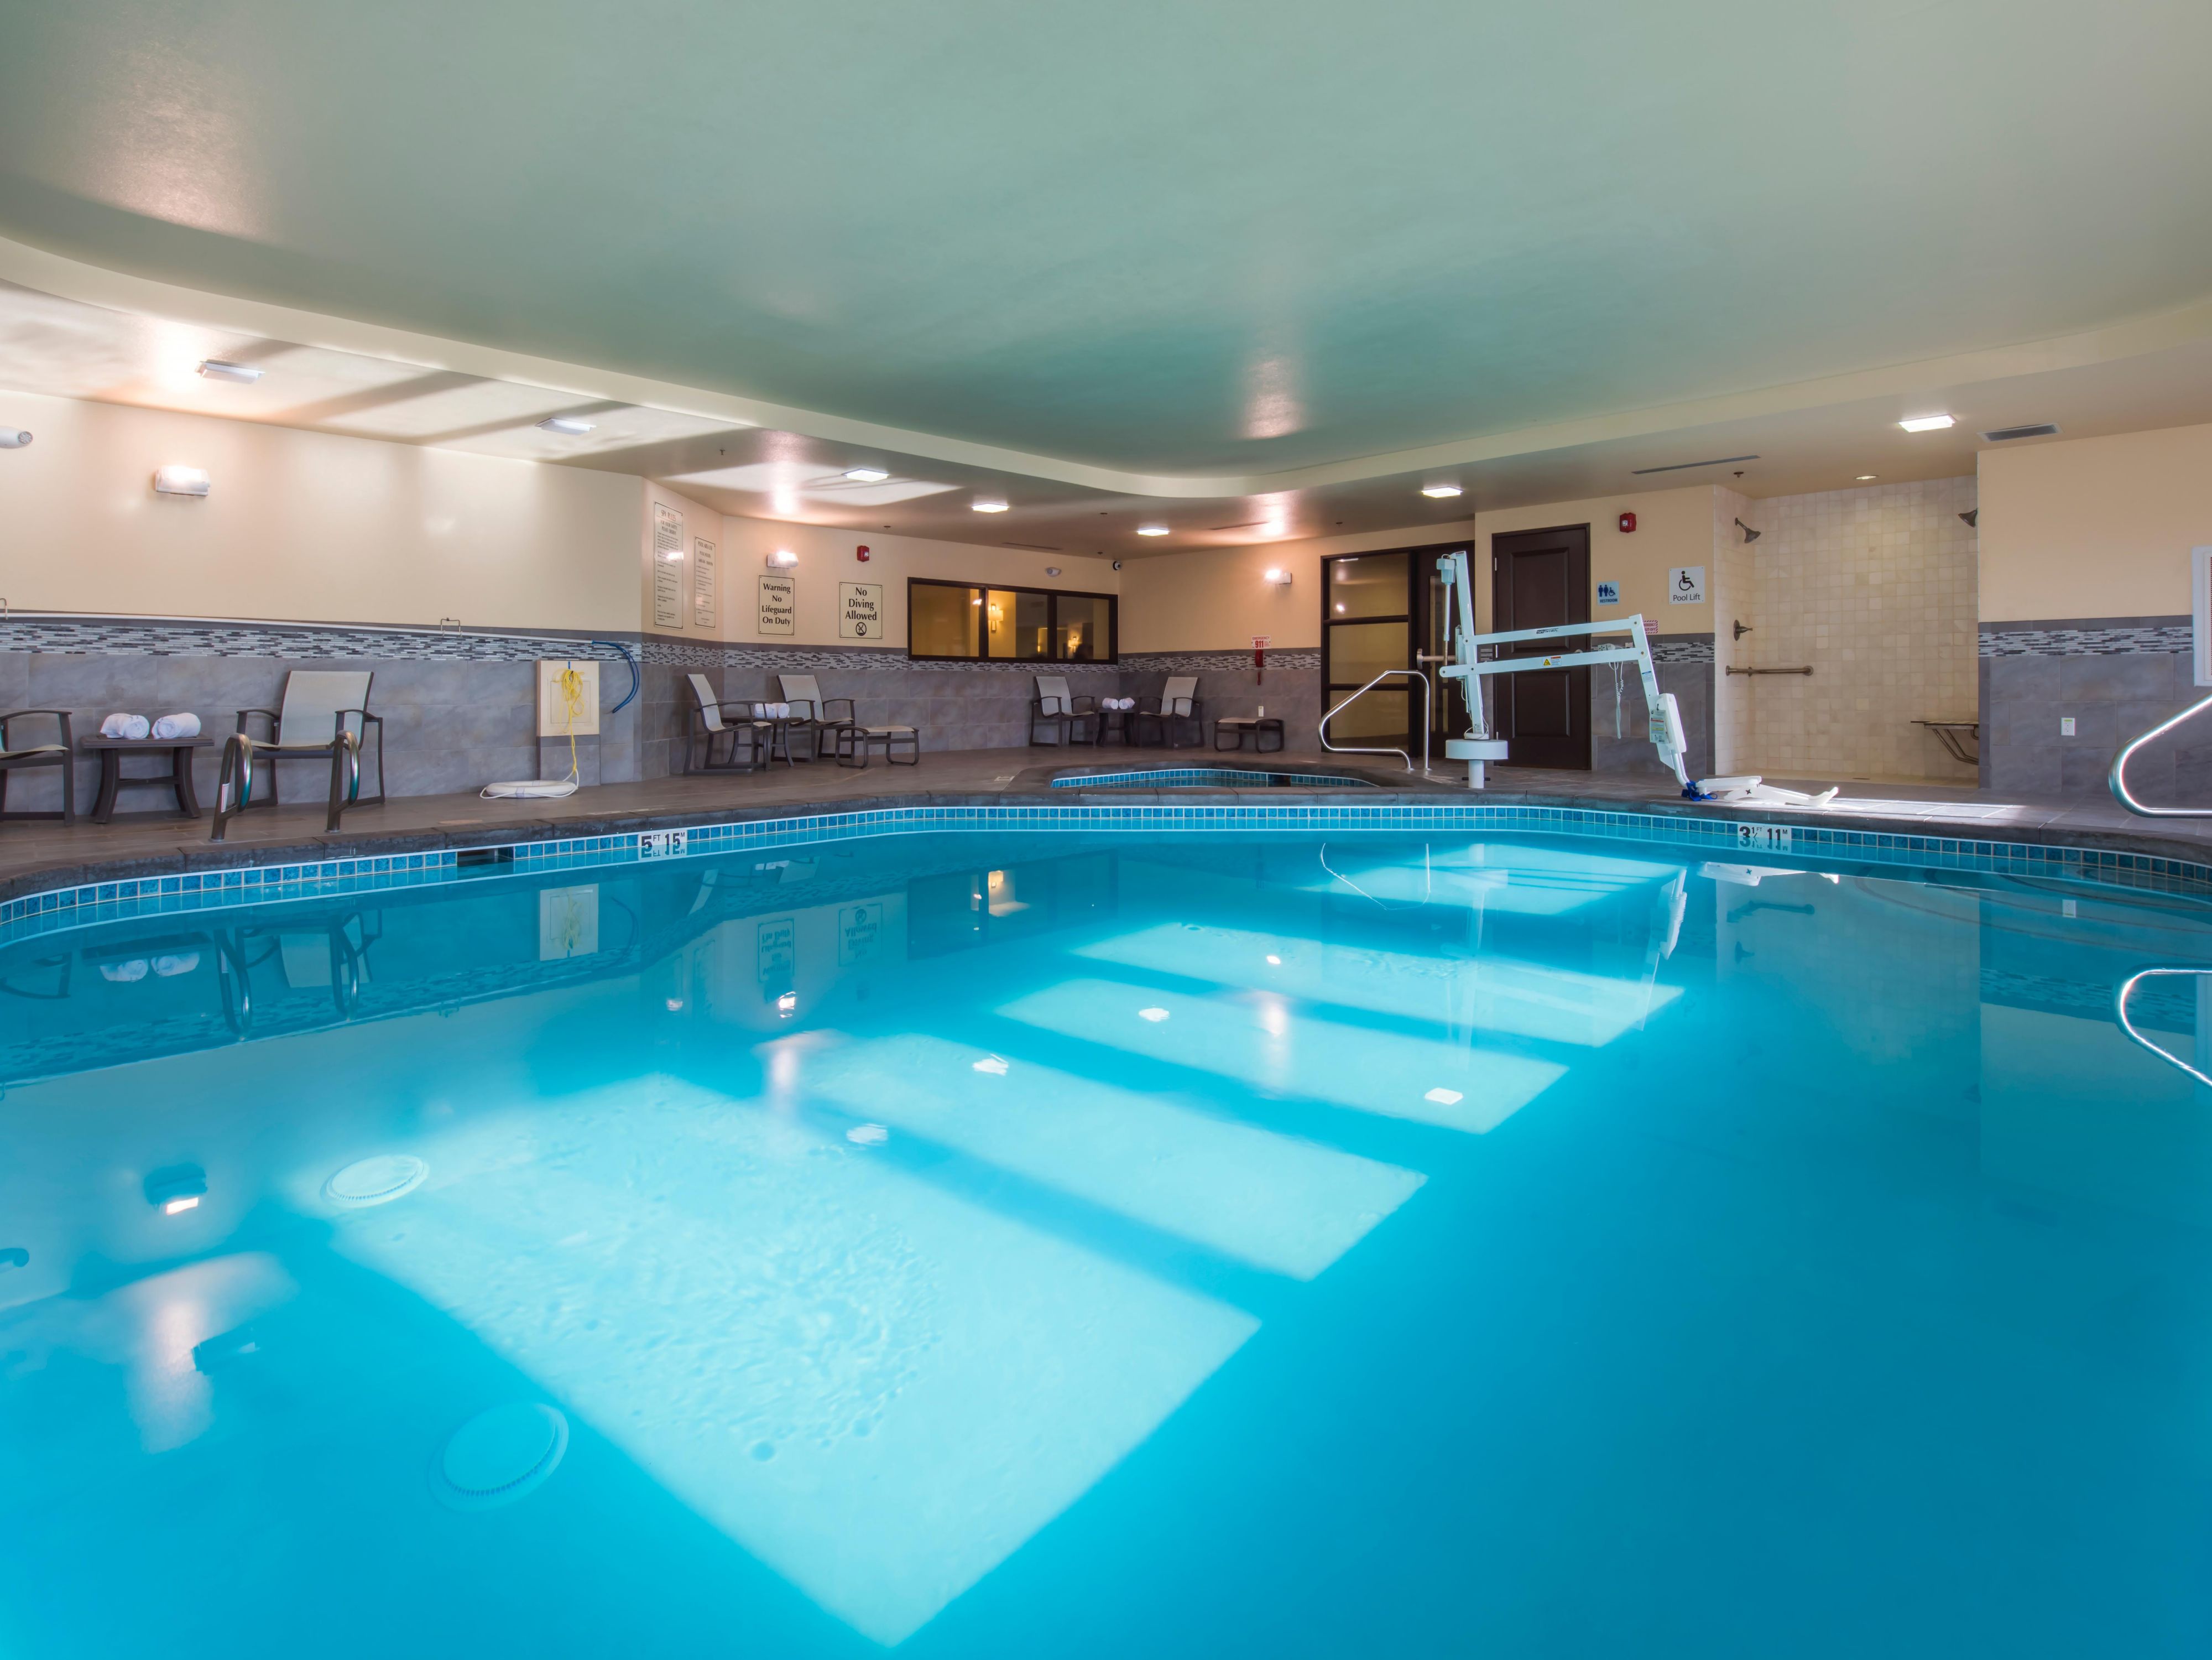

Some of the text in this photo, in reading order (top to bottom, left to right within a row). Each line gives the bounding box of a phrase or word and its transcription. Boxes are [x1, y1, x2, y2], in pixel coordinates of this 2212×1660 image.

[763, 583, 791, 594] Warning
[855, 587, 867, 596] No
[761, 605, 792, 615] Lifeguard
[849, 599, 874, 611] Diving
[845, 610, 877, 621] Allowed
[775, 617, 791, 627] Duty
